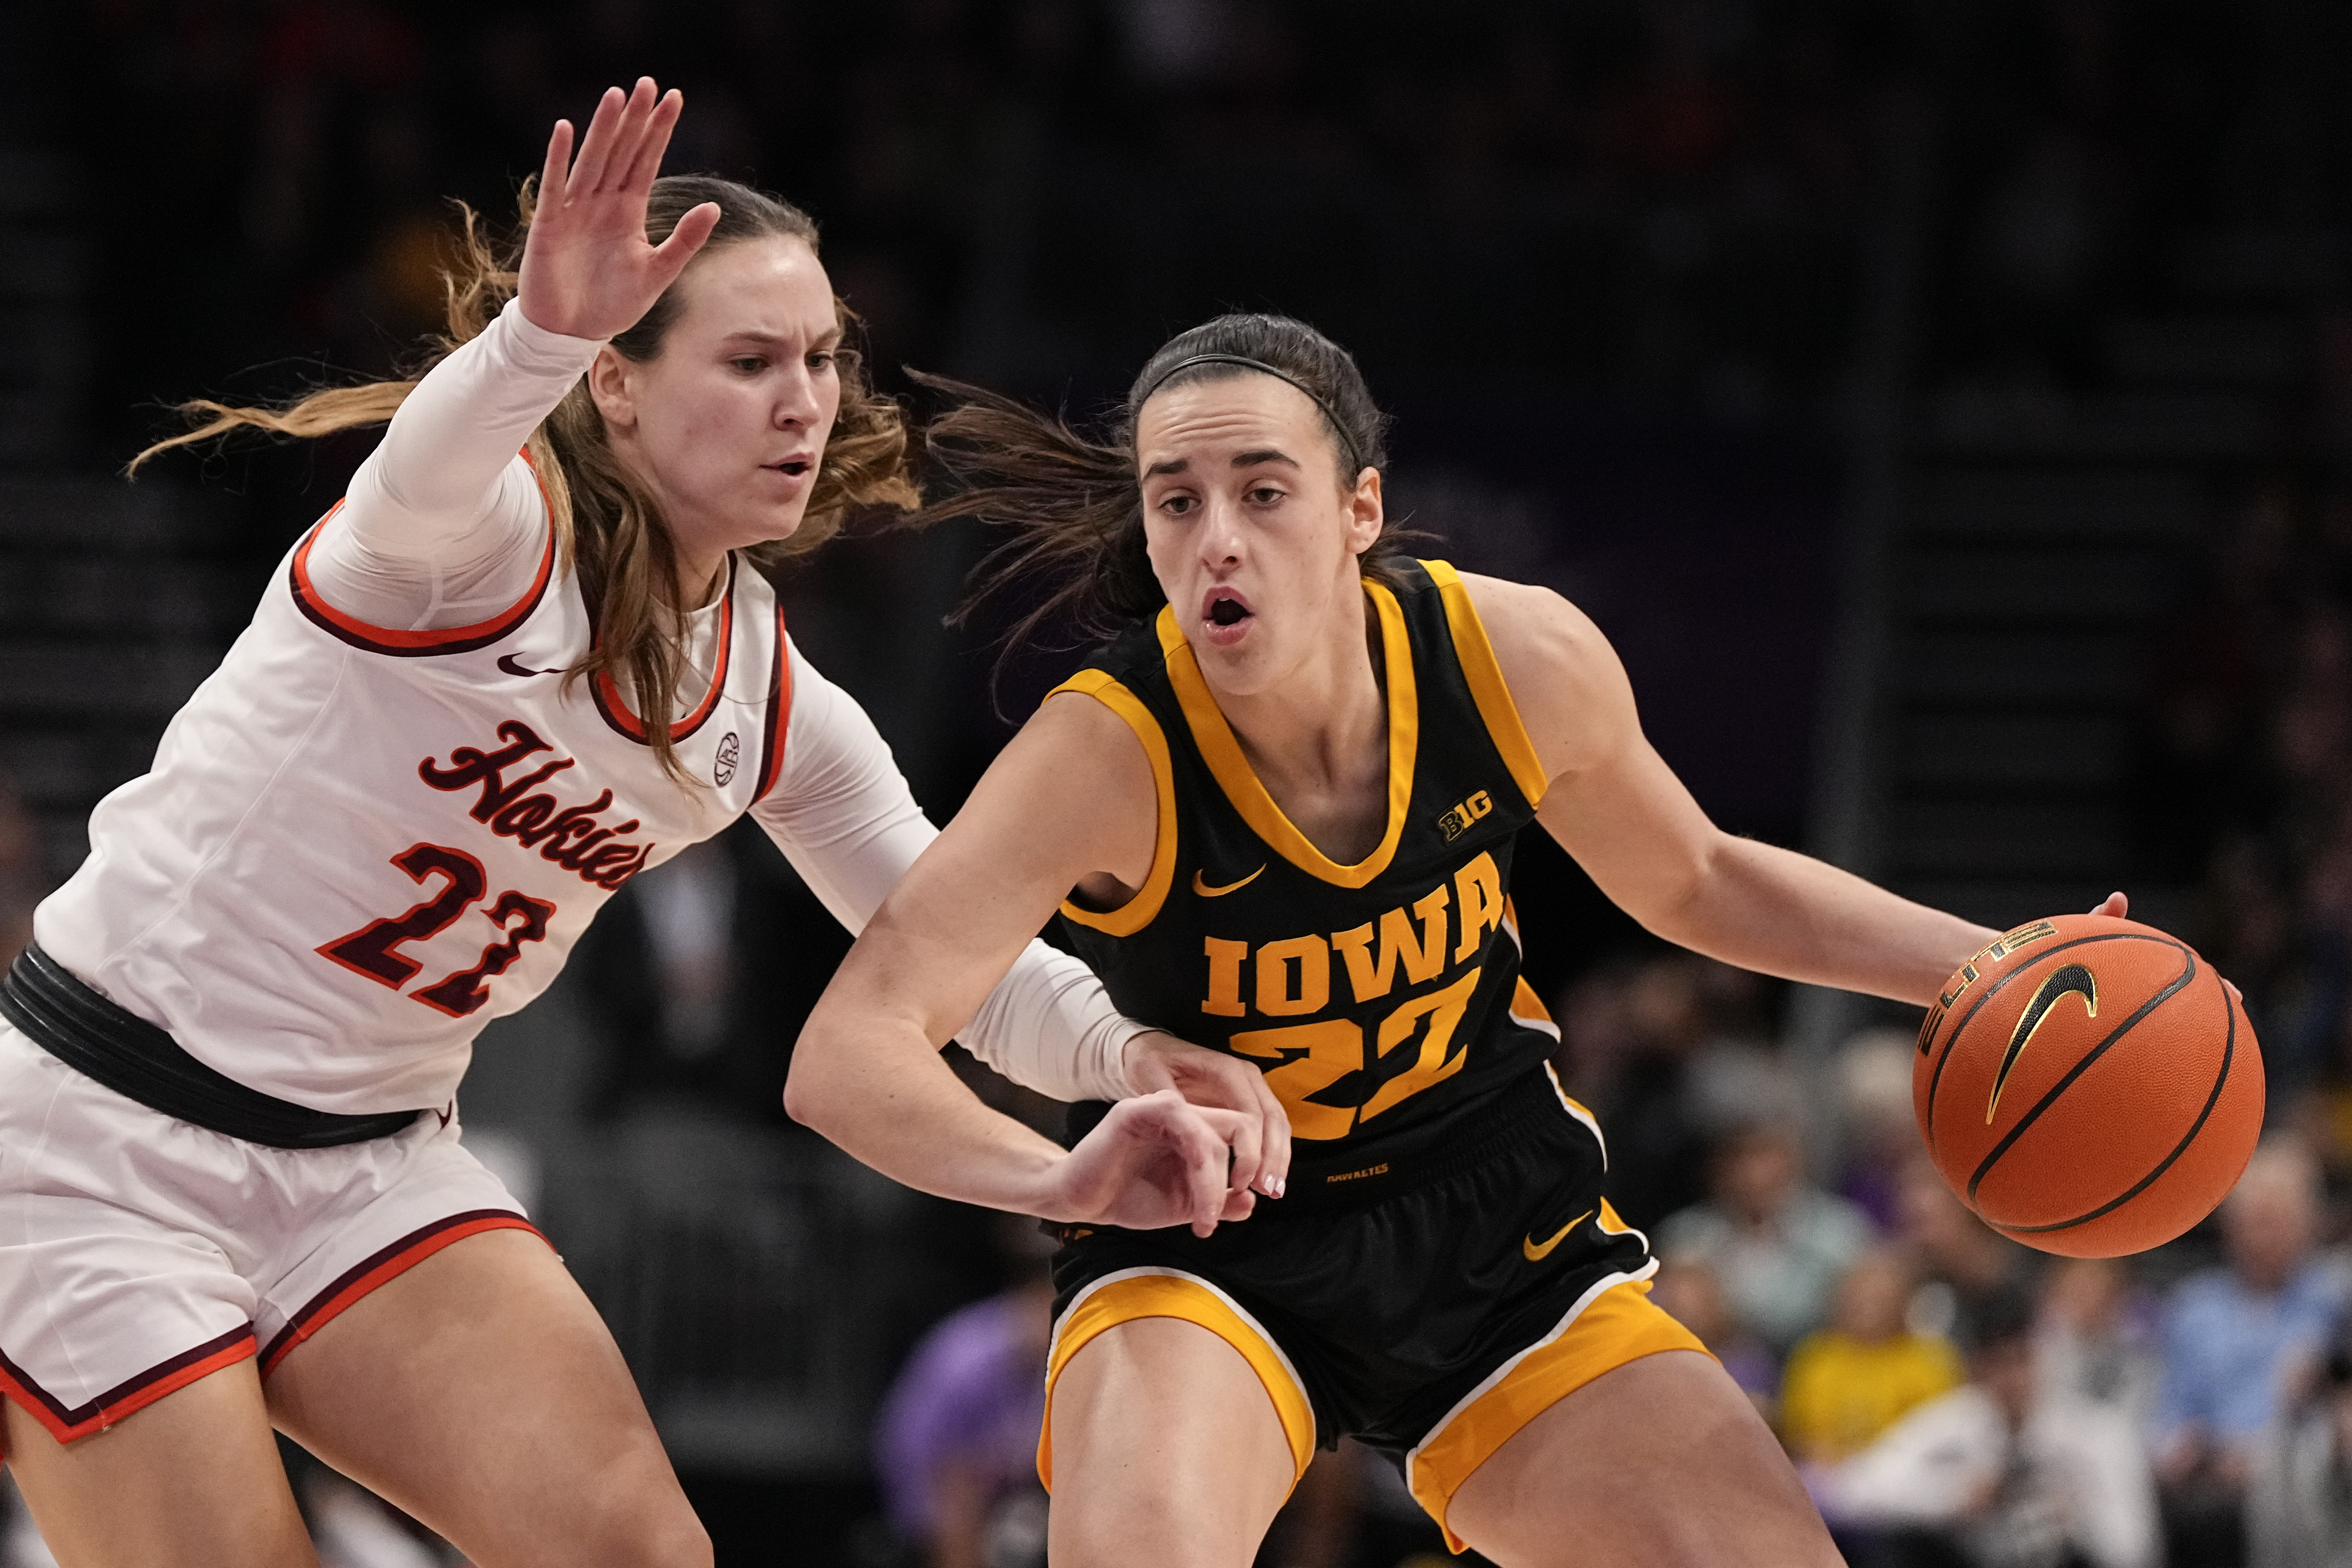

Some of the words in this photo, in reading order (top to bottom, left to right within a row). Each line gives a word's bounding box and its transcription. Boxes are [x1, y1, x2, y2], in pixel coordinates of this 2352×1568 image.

[419, 720, 656, 891] Hokies
[314, 842, 556, 1018] 22
[1202, 851, 1504, 1017] IOWA
[1229, 966, 1481, 1140] 22
